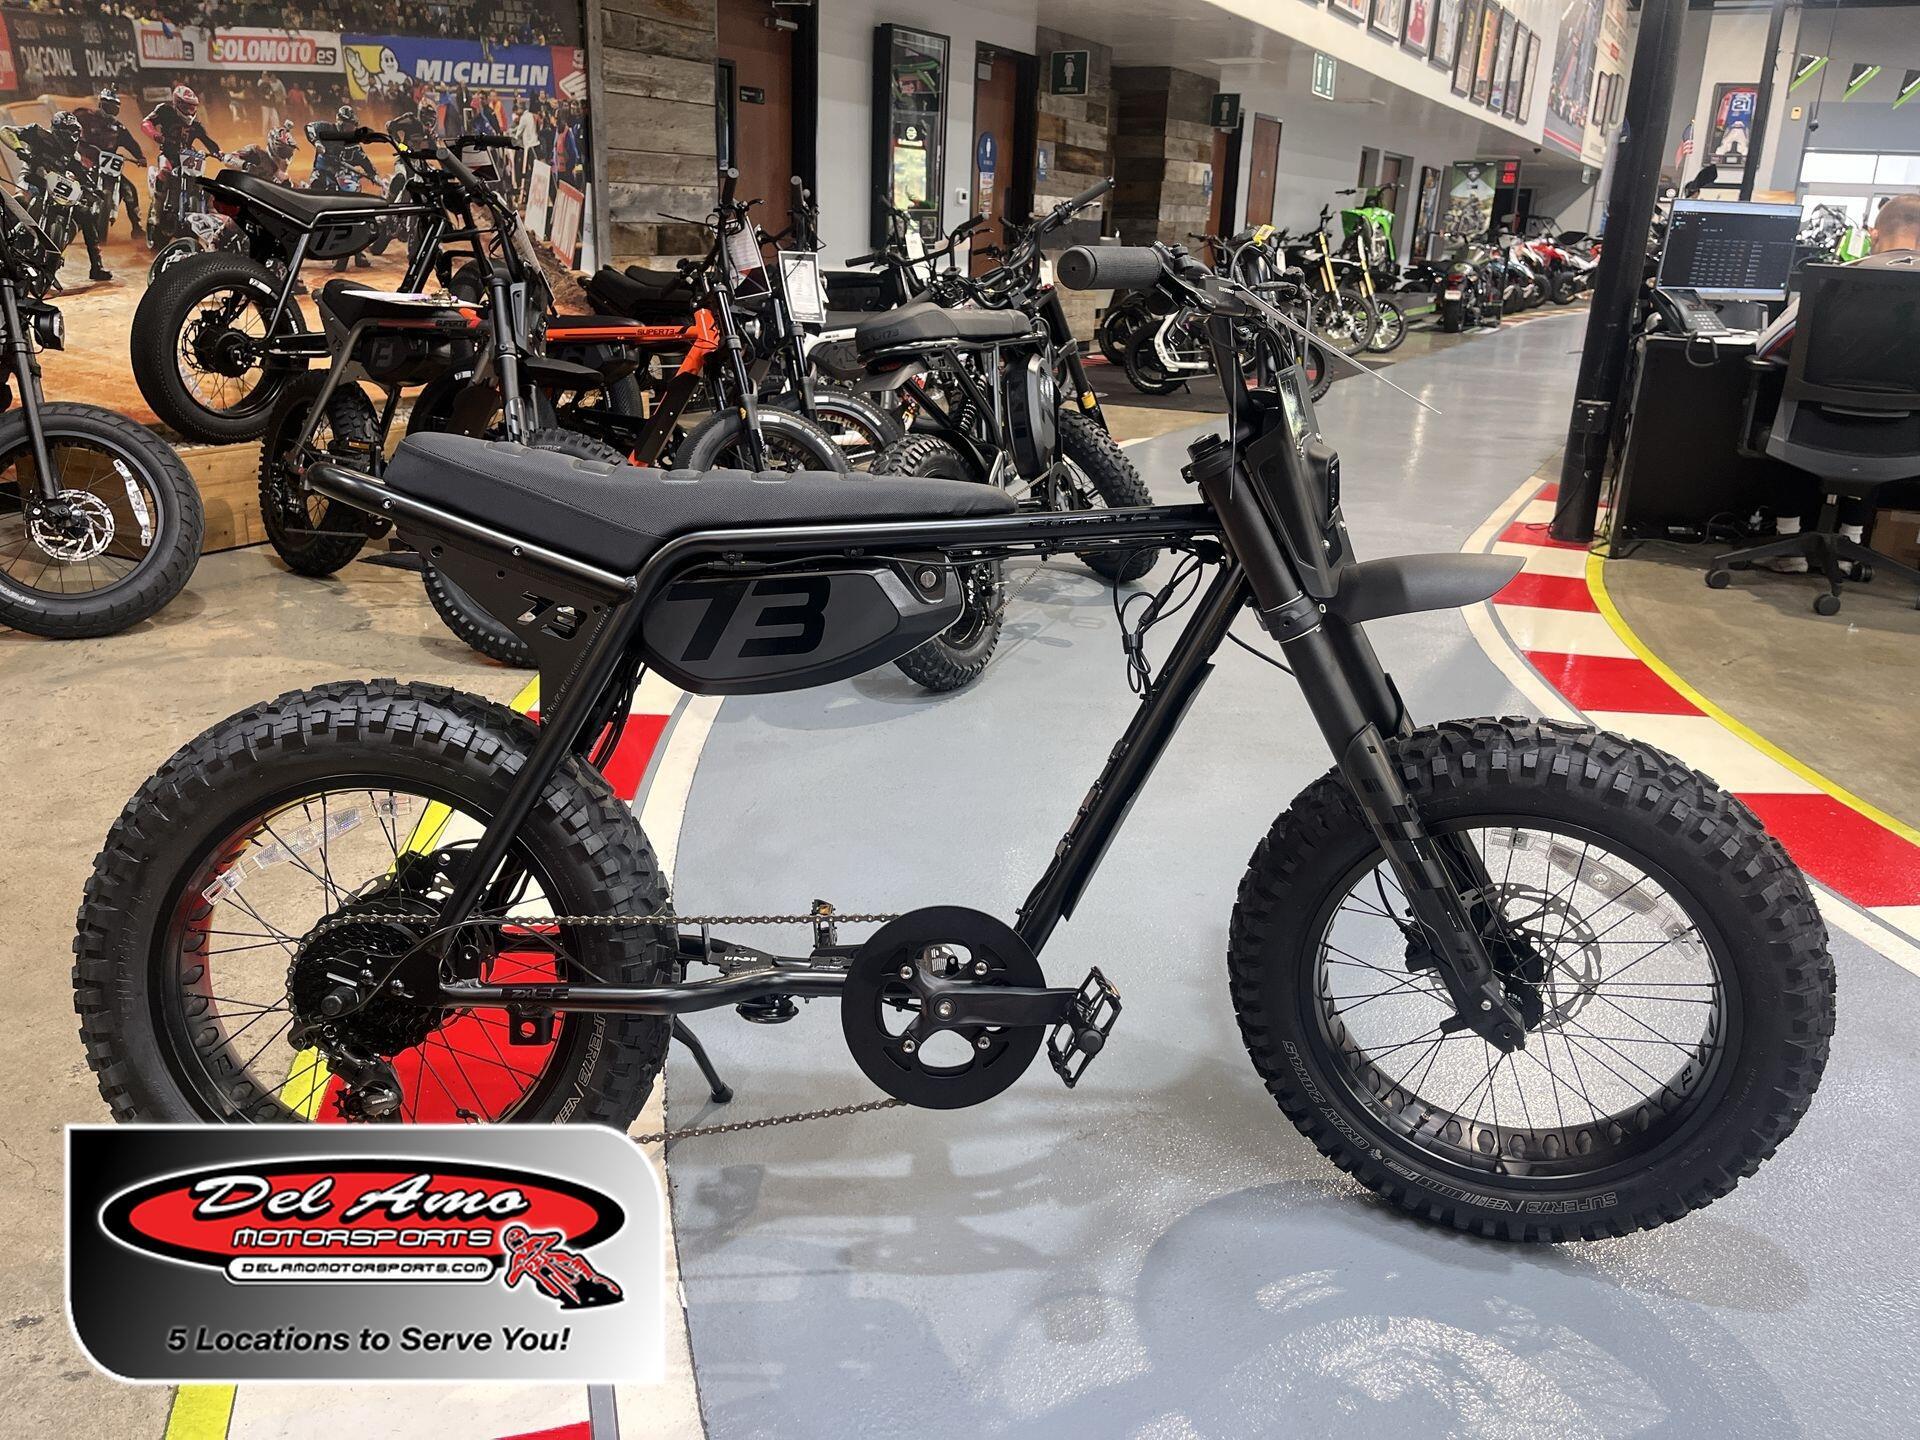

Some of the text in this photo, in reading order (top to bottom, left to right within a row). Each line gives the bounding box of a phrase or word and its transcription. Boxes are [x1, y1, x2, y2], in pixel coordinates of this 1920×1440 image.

[213, 38, 335, 65] SOLOMOTO es
[415, 58, 549, 87] MICHELIN
[101, 154, 123, 172] 78
[637, 328, 676, 336] SUPER73
[515, 590, 588, 641] 73
[667, 575, 831, 662] 73
[1525, 1191, 1618, 1214] SUPER73
